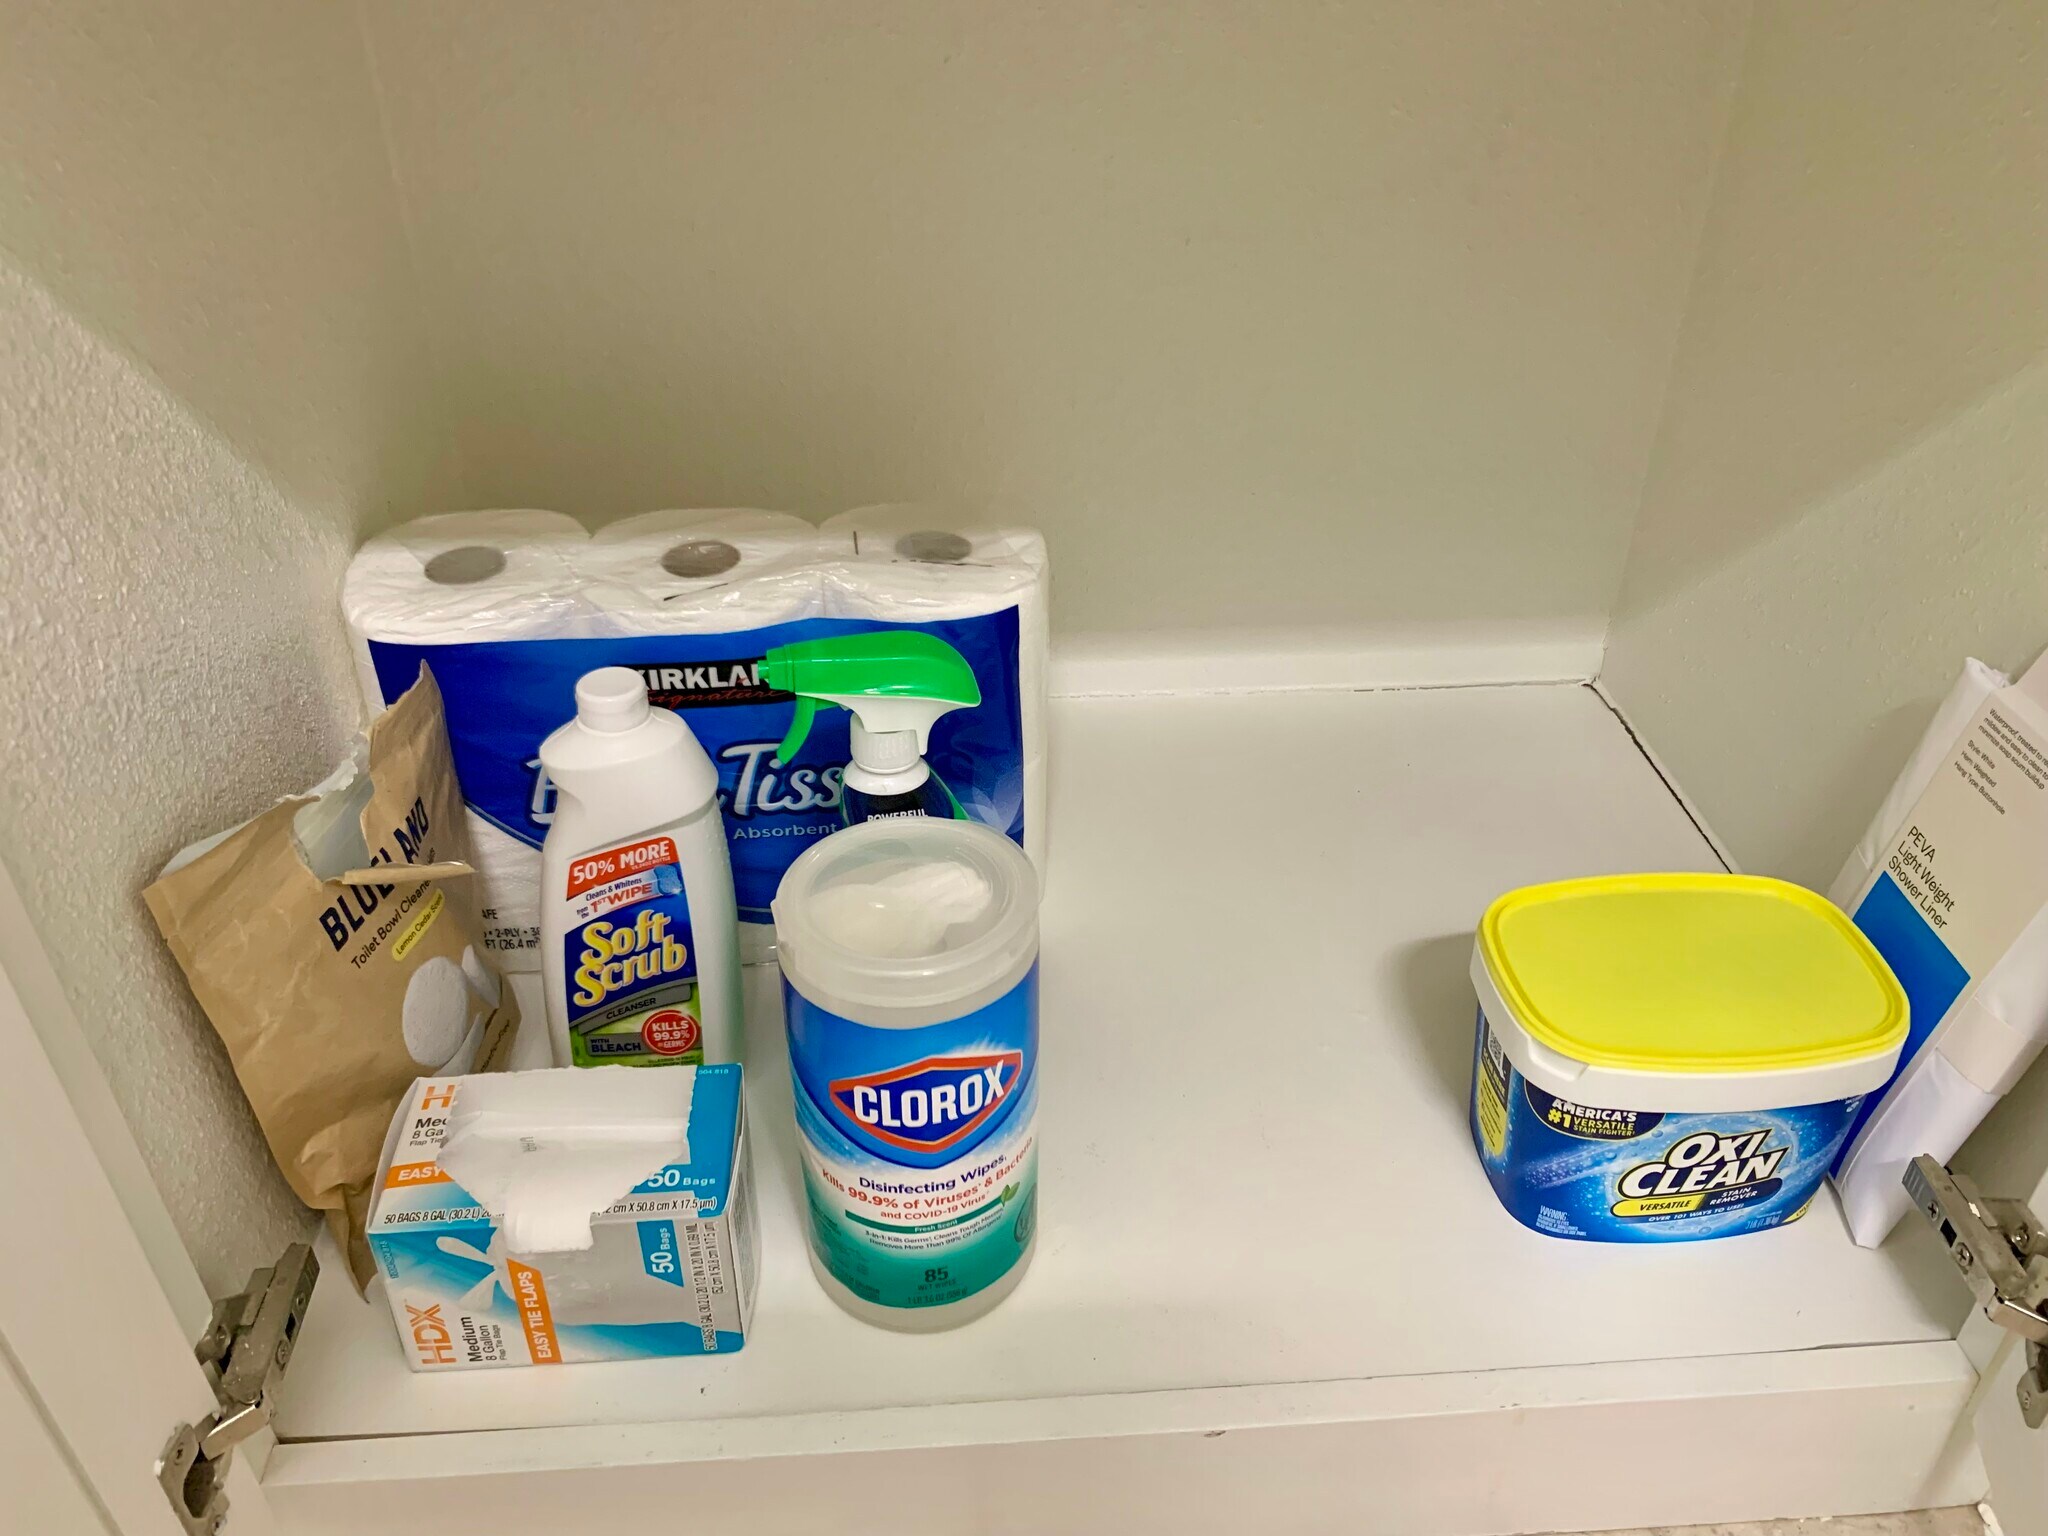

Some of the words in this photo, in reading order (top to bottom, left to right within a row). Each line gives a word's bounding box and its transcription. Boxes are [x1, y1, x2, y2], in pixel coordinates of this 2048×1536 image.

[718, 741, 843, 818] Tiss
[733, 822, 837, 841] Absorbent
[1907, 826, 1935, 863] PEVA
[574, 857, 615, 885] 50%
[620, 840, 670, 869] MORE
[1897, 840, 1922, 874] Light
[1920, 866, 1955, 912] Weight
[586, 887, 607, 901] Cleans
[608, 884, 613, 893] &
[614, 877, 642, 891] Whitens
[606, 882, 653, 906] WIPE
[1888, 855, 1923, 900] Shower
[1920, 895, 1948, 929] Liner
[351, 937, 381, 969] Toilet
[378, 909, 403, 940] Bowl
[395, 930, 416, 955] Lemon
[495, 928, 520, 938] 2-PLY
[580, 909, 671, 964] Soft
[573, 934, 687, 1007] Scrub
[606, 998, 656, 1020] CLEANSER
[652, 1020, 689, 1031] KILLS
[653, 1030, 690, 1041] 99.9%
[592, 1043, 642, 1052] BLEACH
[421, 1084, 456, 1111] H
[853, 1059, 1005, 1128] CLOROX
[1548, 1109, 1572, 1129] #1
[1552, 1099, 1638, 1122] AMERICA'S
[412, 1130, 421, 1139] 8
[425, 1128, 444, 1138] Ga
[1572, 1117, 1635, 1132] VERSATILE
[1573, 1125, 1596, 1134] STAIN
[1666, 1131, 1768, 1169] OXI
[398, 1167, 444, 1181] EASY
[648, 1169, 680, 1187] 50
[682, 1178, 716, 1187] Bags
[822, 1169, 845, 1193] Kills
[848, 1186, 898, 1209] 99.9%
[903, 1198, 920, 1210] of
[984, 1178, 993, 1188] &
[995, 1136, 1034, 1181] Bacteria
[1620, 1149, 1785, 1197] CLEAN
[858, 1176, 956, 1195] Disinfecting
[1721, 1187, 1752, 1198] STAIN
[614, 1204, 626, 1213] cm
[628, 1203, 636, 1212] X
[636, 1202, 654, 1212] 50.8
[656, 1202, 670, 1210] cm
[671, 1200, 678, 1210] X
[680, 1200, 698, 1209] 17.5
[1640, 1200, 1692, 1212] VERSATILE
[1710, 1190, 1758, 1206] REMOVER
[384, 1214, 396, 1224] 50
[397, 1212, 422, 1223] BAGS
[422, 1212, 428, 1222] 8
[430, 1210, 446, 1220] GAL
[448, 1209, 470, 1222] (30.2
[472, 1208, 480, 1221] L)
[880, 1210, 901, 1220] and
[904, 1206, 958, 1220] COVID-19
[1690, 1210, 1712, 1218] WAYS
[914, 1225, 936, 1233] Fresh
[938, 1220, 958, 1230] Scent
[934, 1230, 958, 1240] Cleans
[660, 1228, 670, 1250] Bags
[926, 1241, 944, 1249] Than
[650, 1252, 674, 1273] 50
[924, 1266, 948, 1282] 85
[518, 1271, 540, 1308] FLAPS
[527, 1310, 544, 1328] TIE
[404, 1303, 456, 1365] HDX
[460, 1316, 484, 1362] Medium
[480, 1325, 495, 1354] Gallon
[532, 1330, 552, 1359] EASY
